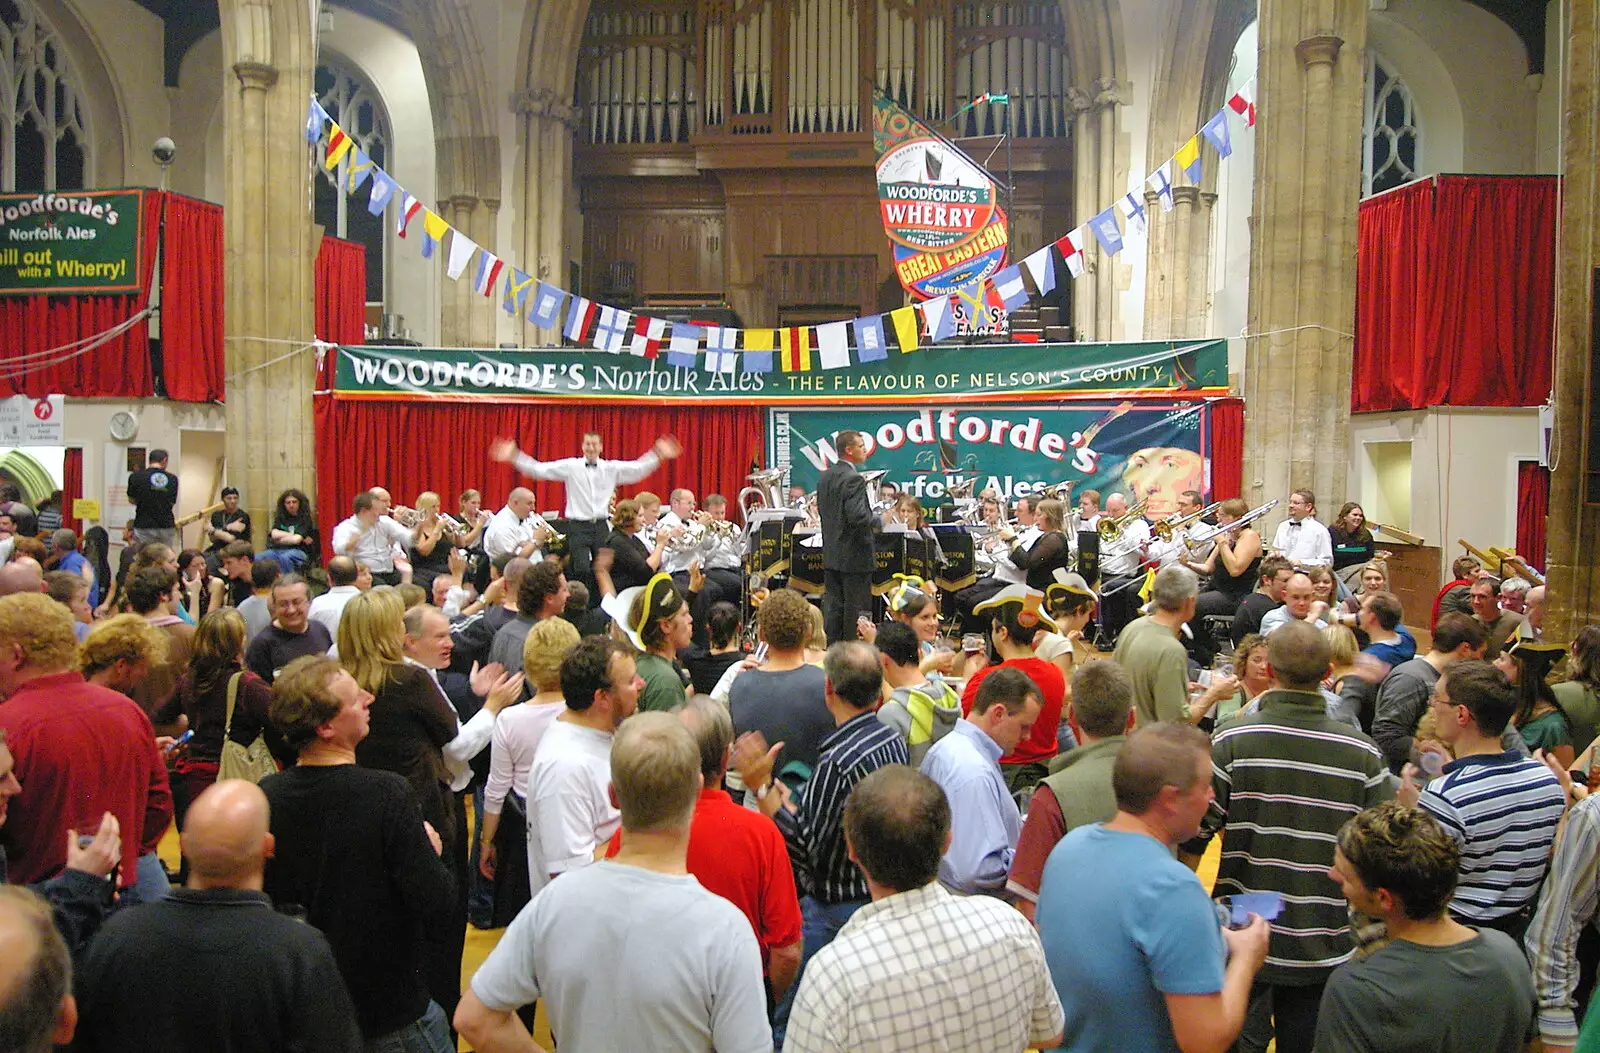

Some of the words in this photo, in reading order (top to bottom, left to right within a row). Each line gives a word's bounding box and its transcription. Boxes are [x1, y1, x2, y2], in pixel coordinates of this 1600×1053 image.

[886, 186, 977, 204] WOODFORDE'S
[885, 203, 976, 228] WHERRY
[9, 227, 63, 241] Norfolk
[66, 226, 97, 240] Ales
[906, 234, 926, 246] BEST
[928, 237, 955, 248] BITTER
[23, 248, 52, 266] out
[898, 252, 943, 285] GREAT
[943, 222, 1008, 267] EASTERN
[18, 266, 42, 279] with
[44, 267, 52, 278] a
[56, 259, 126, 281] Wherry!
[924, 283, 958, 295] BREWED
[968, 257, 998, 286] NORFOLK
[352, 358, 586, 391] WOODFORDE'S
[592, 355, 700, 395] Norfolk
[705, 353, 765, 391] Ales
[788, 376, 825, 391] THE
[834, 374, 926, 391] FLAVOUR
[934, 372, 960, 389] OF
[970, 369, 1071, 388] NELSON'S
[1079, 364, 1164, 383] COUNTY
[887, 475, 971, 500] rfol
